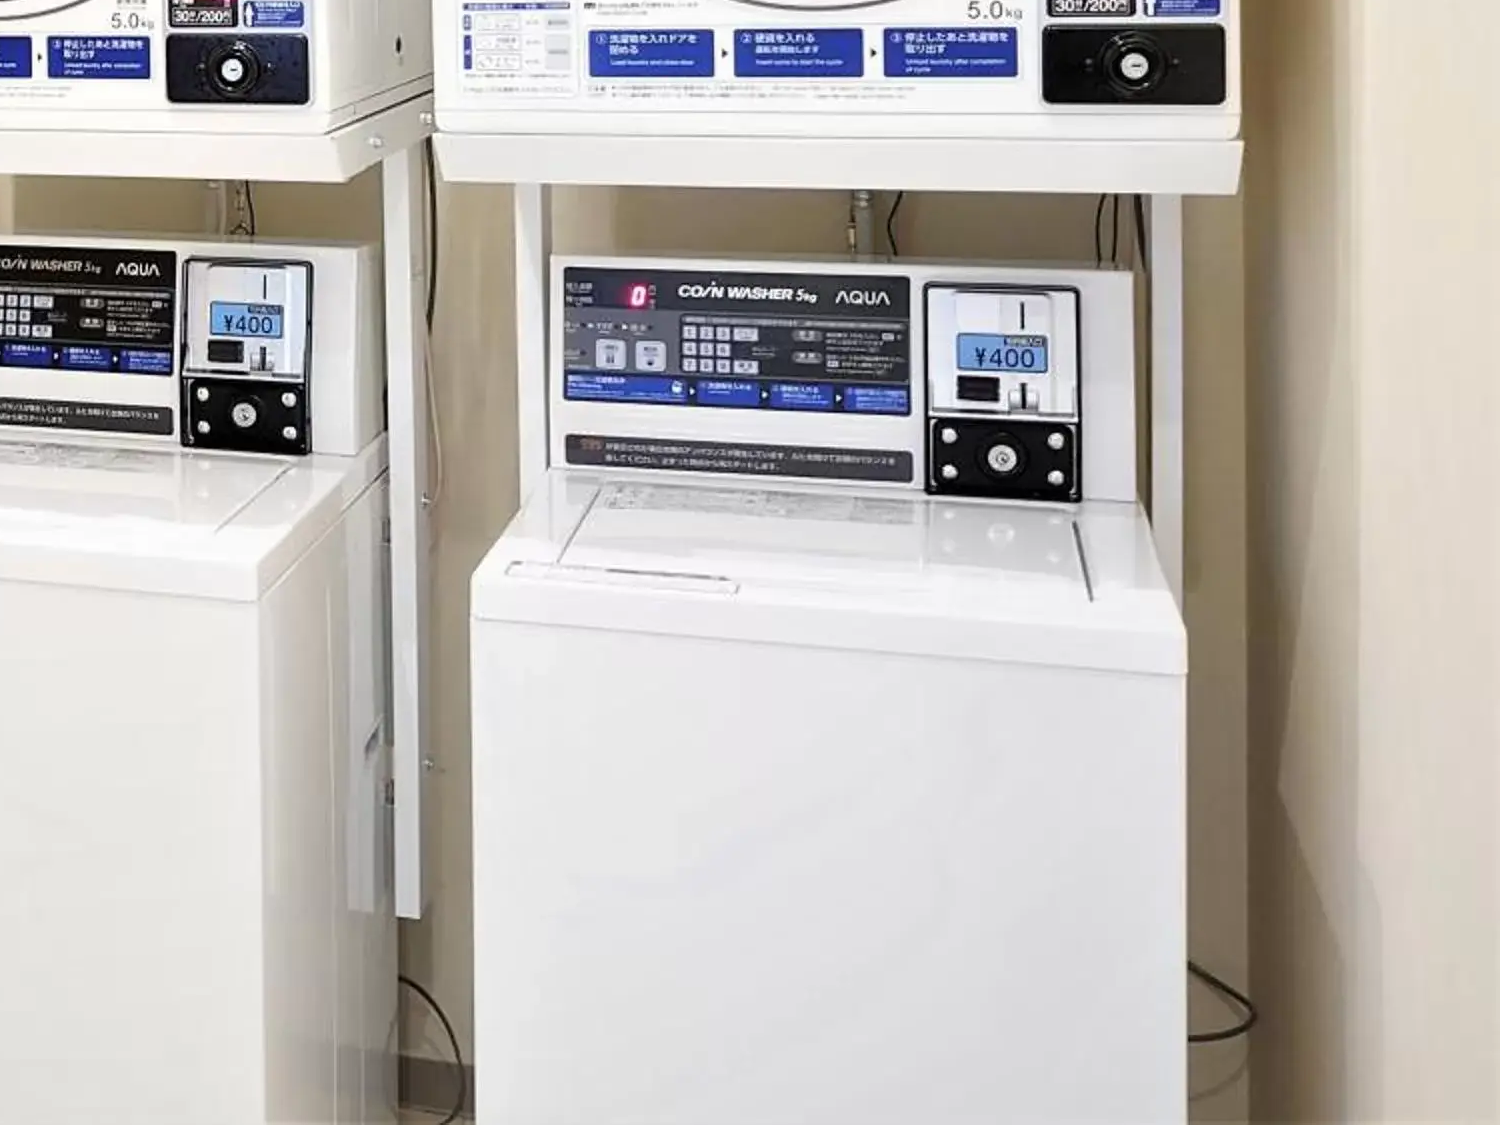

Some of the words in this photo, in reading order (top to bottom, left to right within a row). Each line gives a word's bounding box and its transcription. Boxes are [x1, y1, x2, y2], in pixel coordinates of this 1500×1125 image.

[30, 258, 83, 272] WASHER
[115, 262, 161, 276] AQUA
[631, 285, 647, 307] 0
[727, 285, 793, 301] WASHER
[835, 289, 891, 305] AQUA
[223, 315, 273, 334] ¥400
[974, 346, 1035, 368] ¥400
